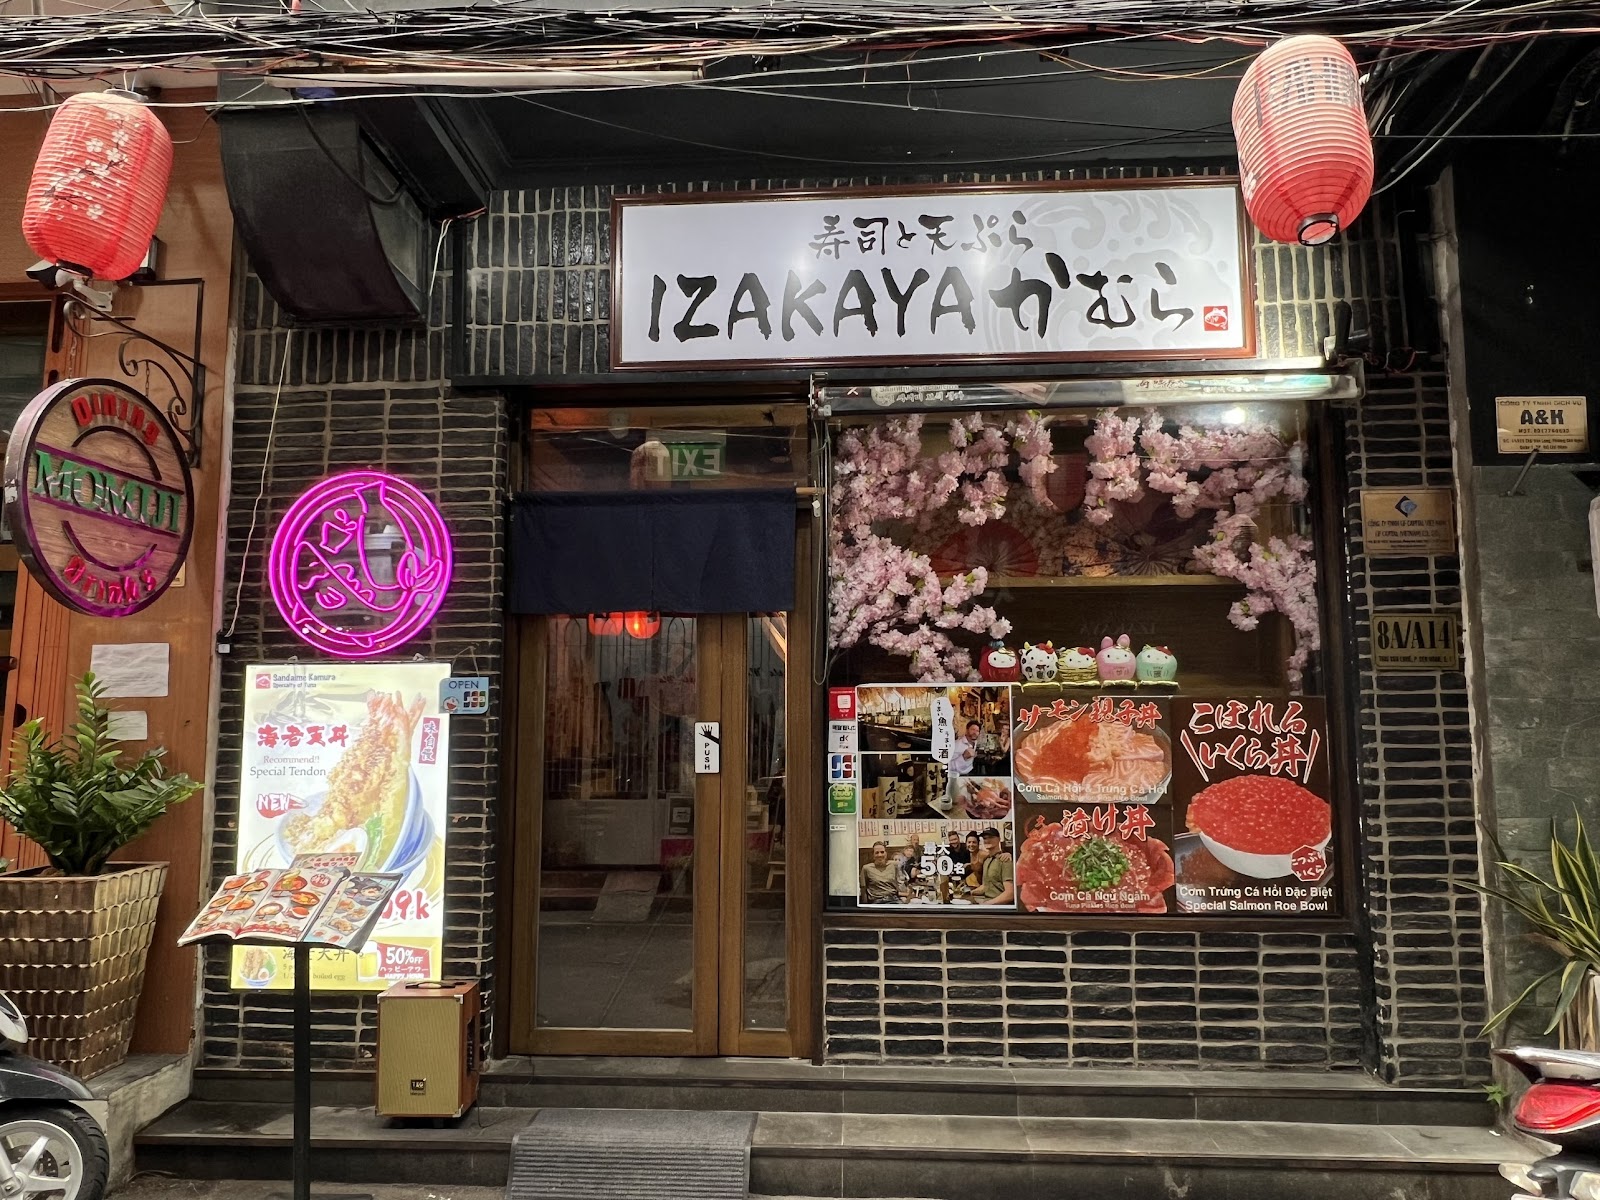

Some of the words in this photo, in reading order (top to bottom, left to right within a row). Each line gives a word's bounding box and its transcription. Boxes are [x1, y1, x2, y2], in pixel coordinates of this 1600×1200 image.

[809, 210, 1034, 260] 寿司と天ぷら
[646, 265, 976, 343] IZAKAYA
[988, 252, 1195, 340] かむら
[1520, 409, 1565, 425] A&H
[32, 450, 182, 532] MOMIJI
[273, 674, 306, 682] Sandaime
[308, 673, 336, 682] Kamura
[448, 680, 479, 689] OPEN
[1017, 697, 1163, 731] サーモン親子丼
[1188, 699, 1308, 735] こぼれる
[257, 723, 349, 749] 海老天丼
[703, 742, 711, 771] PUSH
[1199, 733, 1310, 778] いくら丼
[250, 766, 286, 778] Special
[288, 766, 327, 776] Tendon
[1061, 803, 1156, 841] 漬け丼
[1179, 886, 1206, 897] Cơm
[1208, 886, 1242, 899] Trứng
[1244, 885, 1260, 897] Cá
[1285, 886, 1307, 899] Đặc
[1310, 886, 1333, 899] Biệt
[1185, 900, 1227, 913] Special
[1229, 900, 1272, 911] Salmon
[1274, 901, 1297, 911] Roe
[1300, 900, 1328, 911] Bowl
